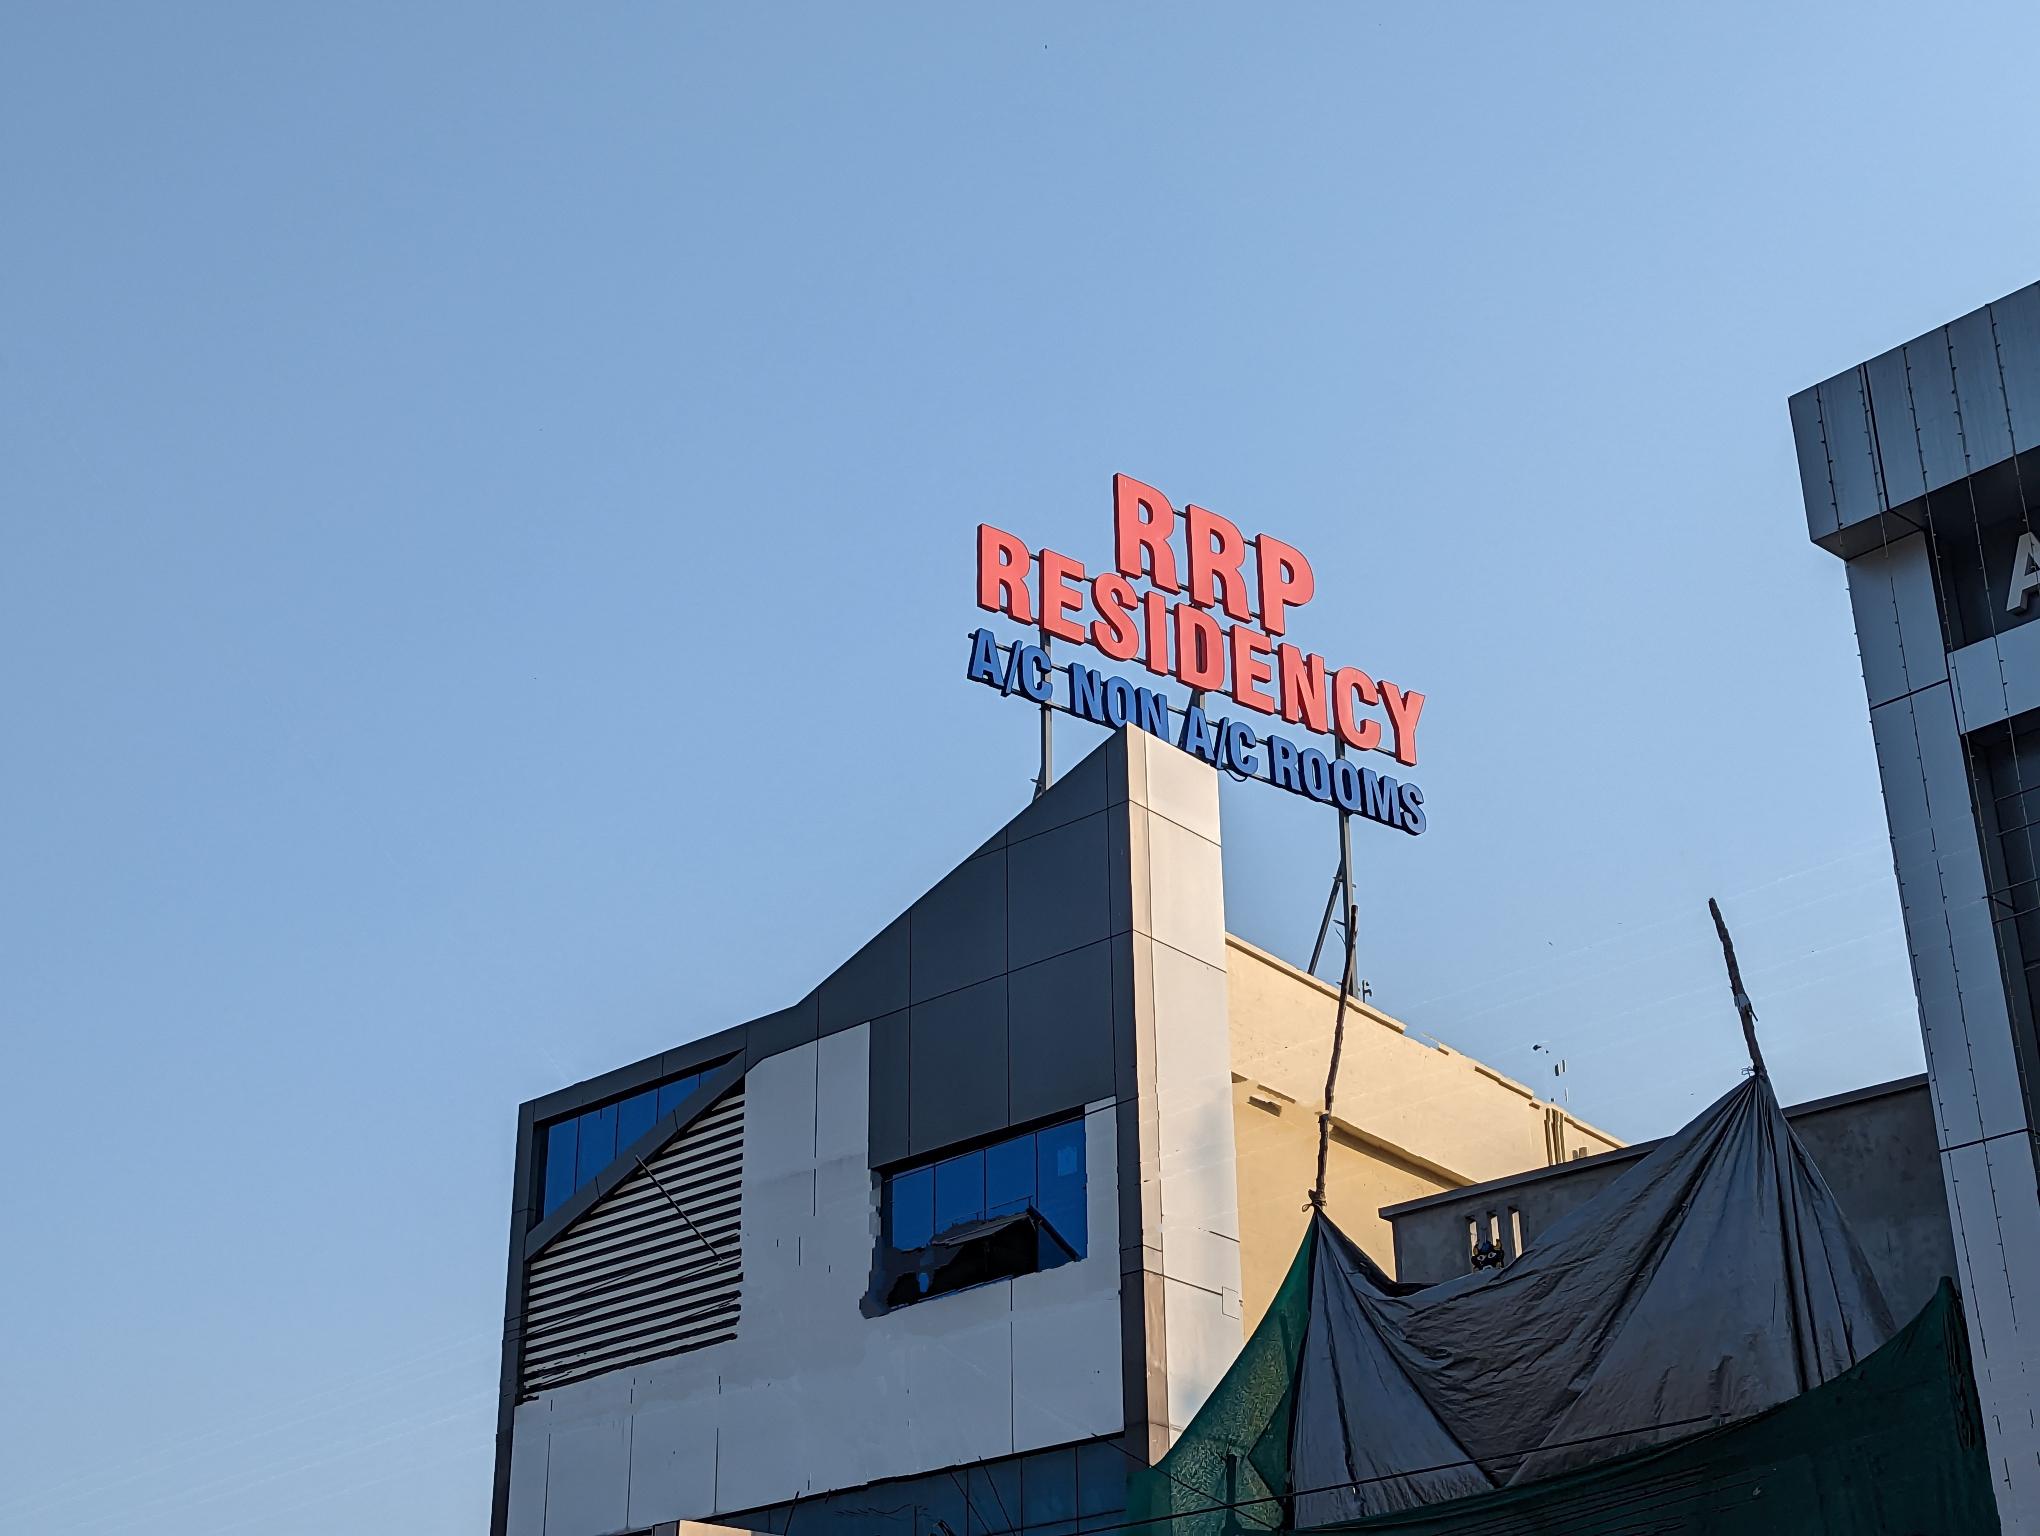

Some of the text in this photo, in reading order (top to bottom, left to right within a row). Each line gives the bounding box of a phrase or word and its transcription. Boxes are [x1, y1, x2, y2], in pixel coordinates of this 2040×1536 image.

[977, 523, 1425, 766] RESIDENCY
[1113, 472, 1314, 636] RRP
[967, 628, 1426, 835] A/C NON A/C ROOMS
